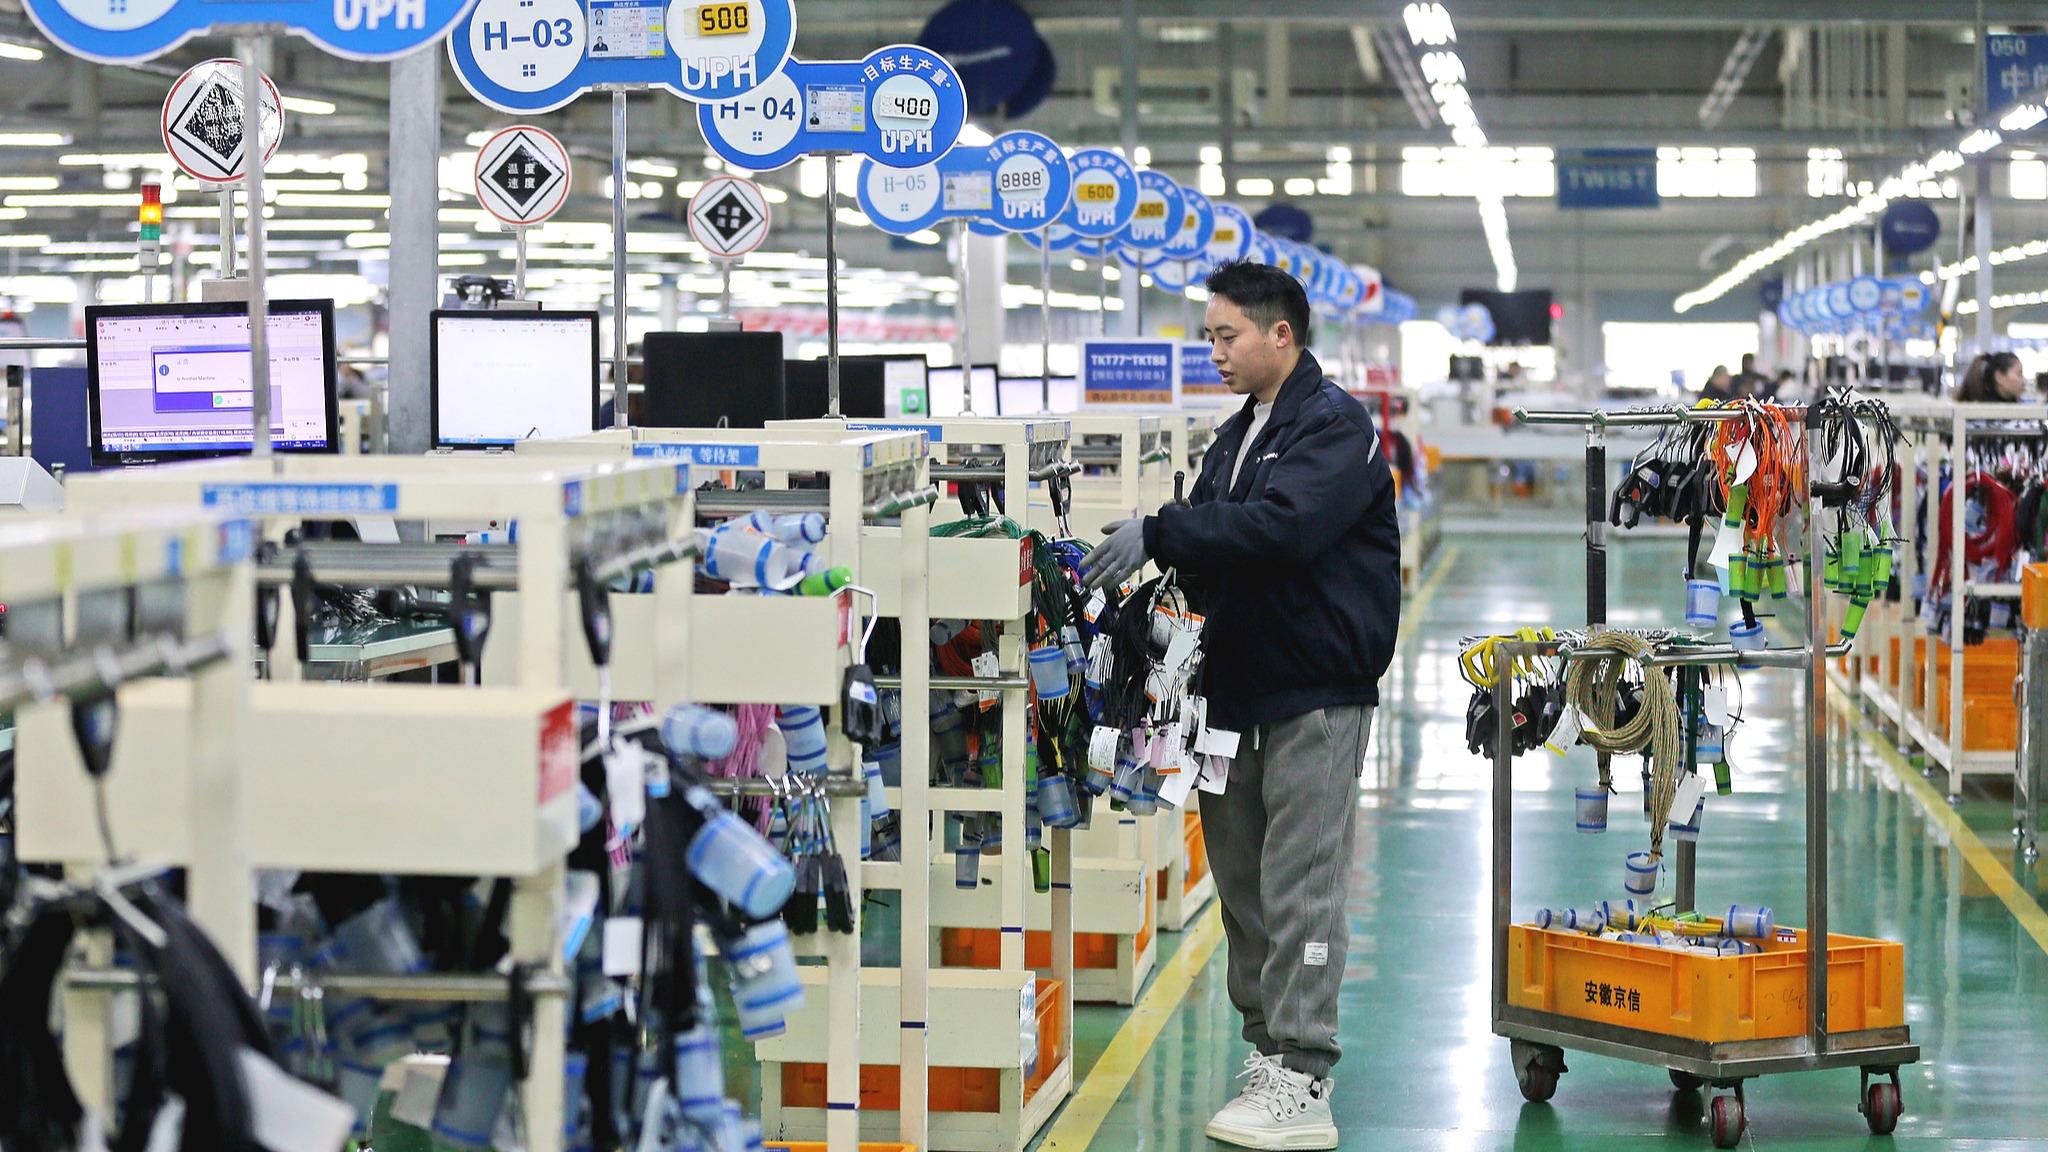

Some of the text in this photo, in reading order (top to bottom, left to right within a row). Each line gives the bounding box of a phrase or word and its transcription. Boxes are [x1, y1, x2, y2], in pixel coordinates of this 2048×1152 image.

[334, 0, 426, 31] UPH
[483, 19, 573, 50] H-03
[1991, 39, 2026, 56] 050
[679, 56, 757, 90] UPH
[863, 54, 948, 88] 目标生产量
[720, 97, 796, 121] H-04
[880, 129, 933, 153] UPH
[508, 163, 535, 174] 温度
[508, 178, 535, 189] 速度
[884, 174, 927, 193] H-05
[1568, 169, 1648, 190] TWIST
[1087, 185, 1115, 199] 600
[1003, 199, 1046, 219] UPH
[1077, 207, 1116, 226] UPH
[1584, 980, 1641, 1013] 安徽京信
